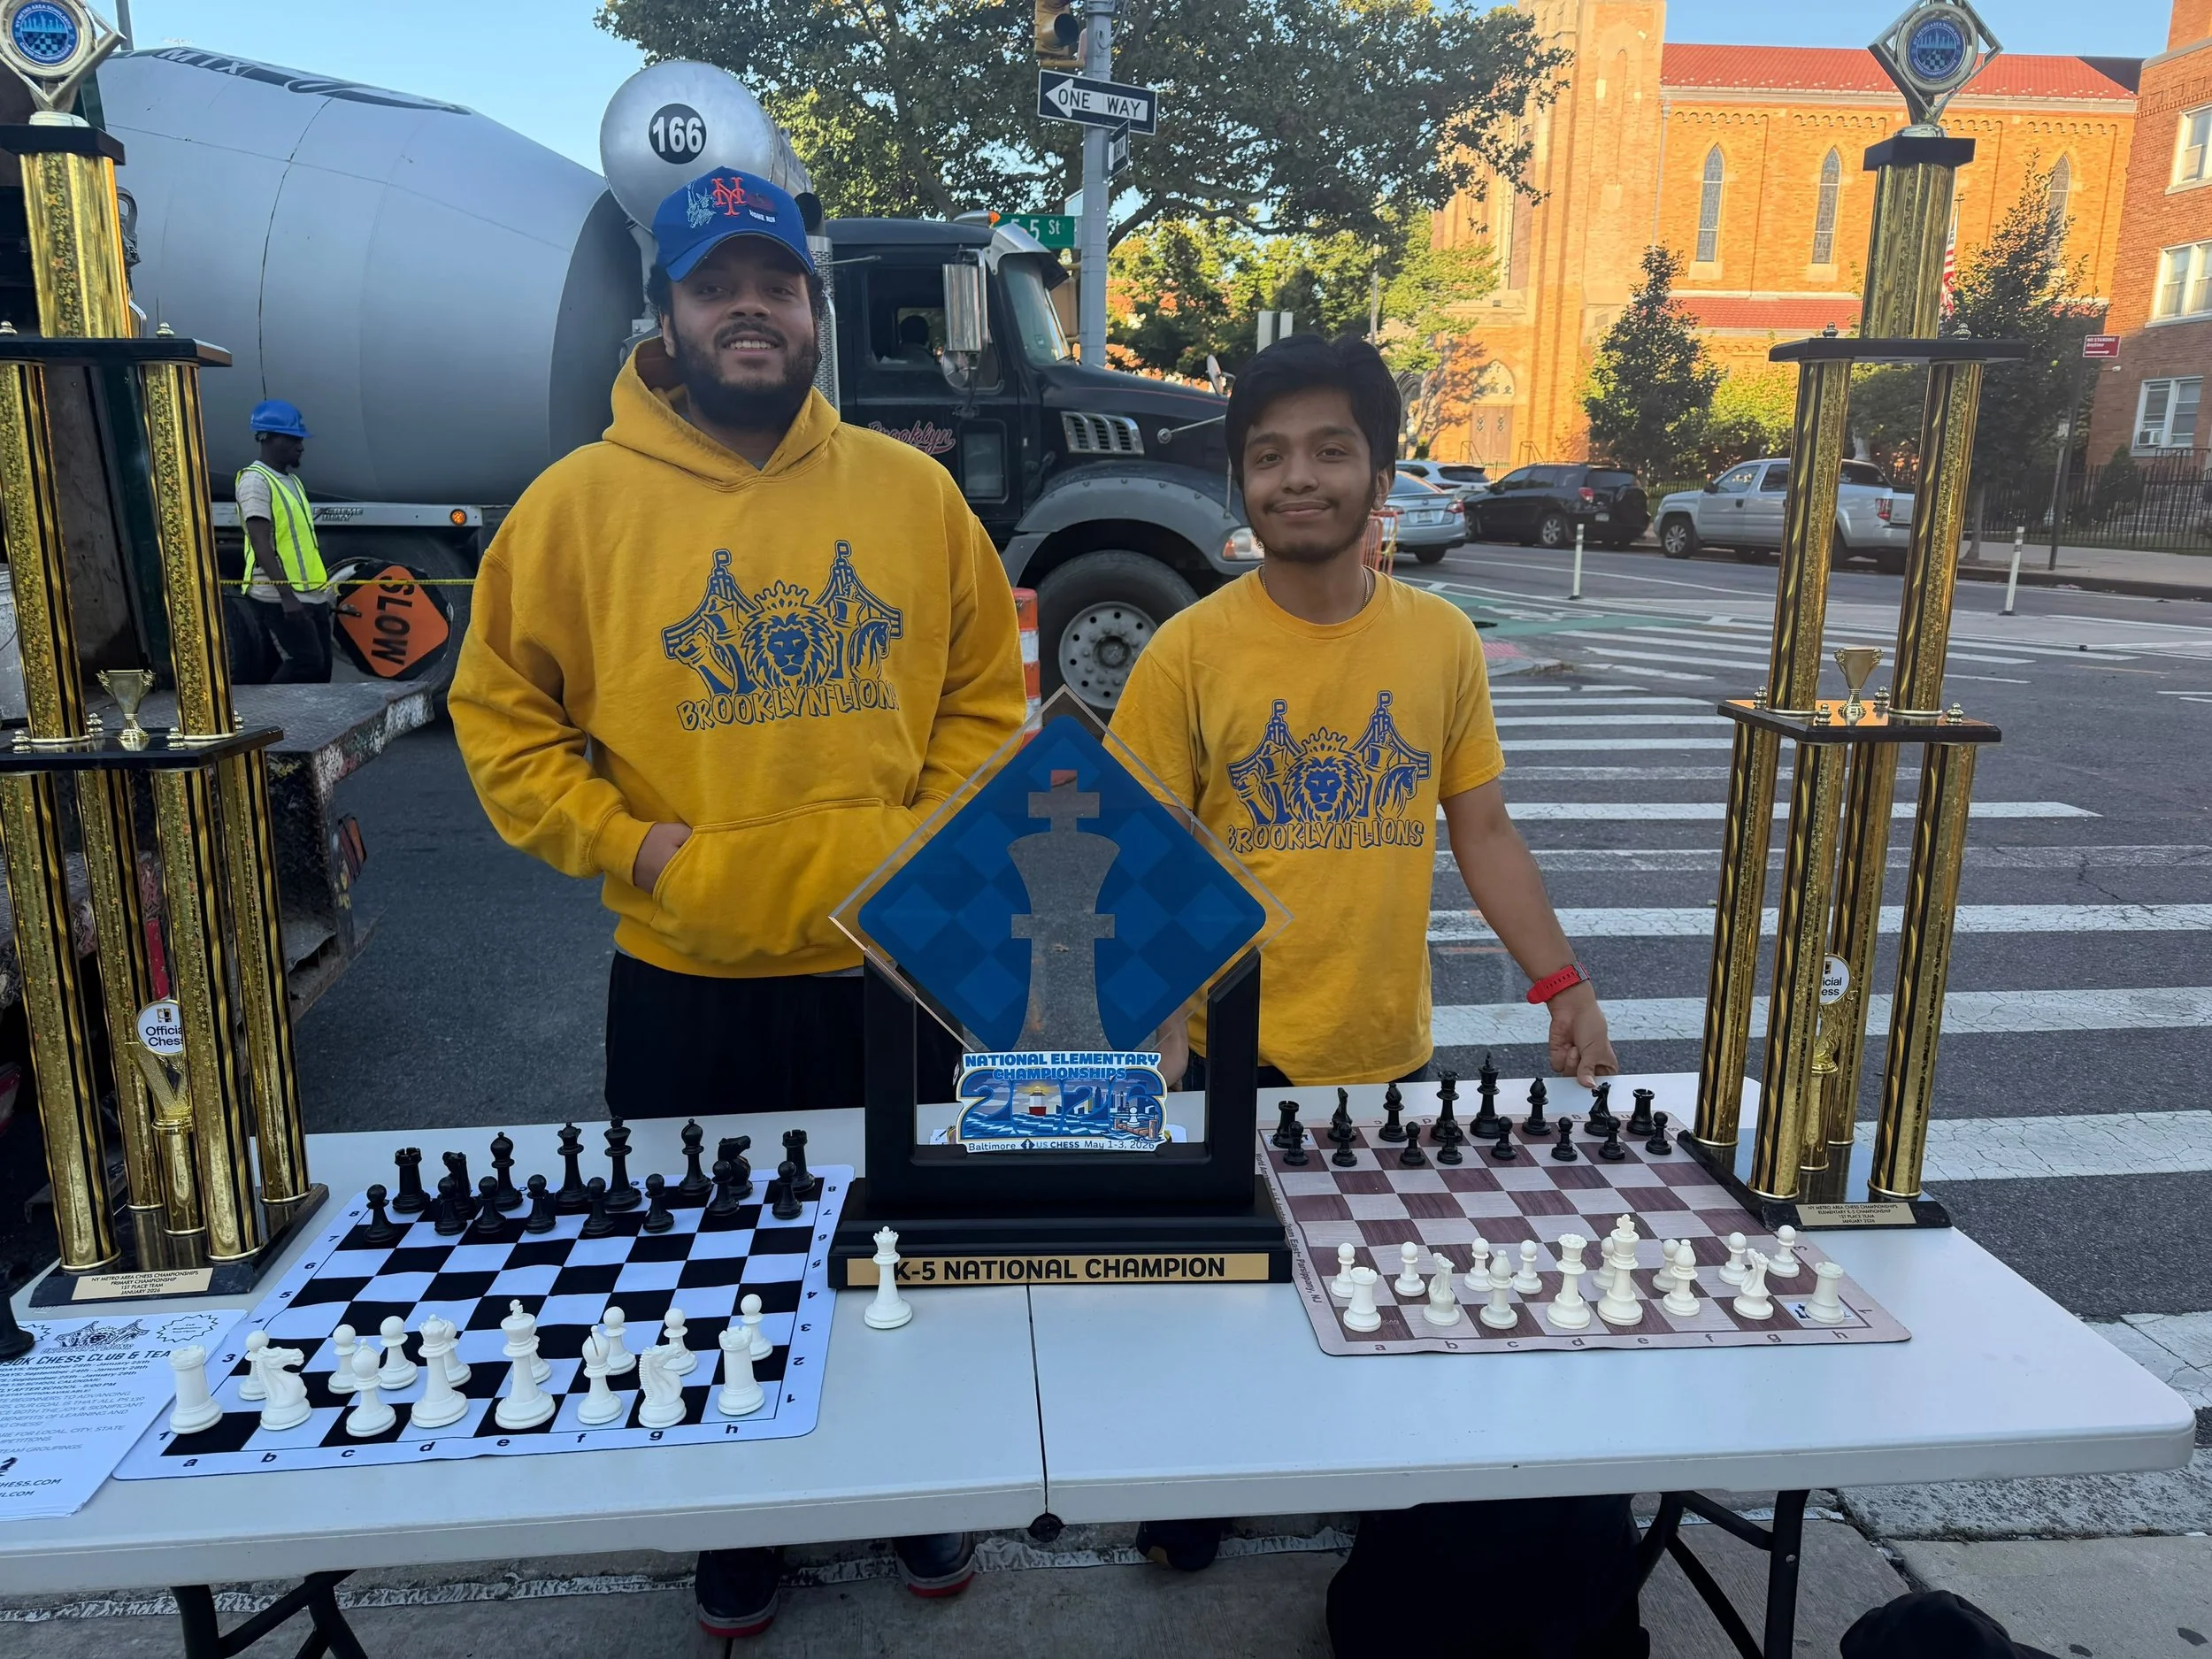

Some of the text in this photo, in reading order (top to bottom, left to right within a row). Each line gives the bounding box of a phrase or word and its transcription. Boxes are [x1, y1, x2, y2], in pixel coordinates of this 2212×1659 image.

[1058, 88, 1141, 118] ONE WAY
[652, 116, 703, 153] 166
[711, 177, 748, 217] NY
[1048, 219, 1061, 234] St
[372, 575, 415, 665] SLOW
[676, 679, 899, 731] BROOKLYN LION
[1228, 818, 1425, 854] BROOKLYN LIONS
[1822, 977, 1842, 986] icial
[145, 1025, 182, 1036] Officia
[965, 1052, 1160, 1067] NATIONAL ELEMENTARY
[992, 1067, 1127, 1080] CHAMPIONSHIPS
[968, 1142, 1017, 1151] Baltimore
[1050, 1141, 1080, 1149] CHESS
[1084, 1141, 1104, 1150] May
[1130, 1141, 1156, 1149] 2026
[893, 1257, 1225, 1281] K-5 NATIONAL CHAMPION
[1310, 1294, 1323, 1303] NJ
[1445, 1340, 1458, 1349] b
[1571, 1338, 1586, 1347] d
[36, 1355, 86, 1364] CHESS
[87, 1352, 126, 1362] CLUB
[143, 1350, 172, 1359] TEA
[183, 1458, 198, 1468] a
[261, 1453, 277, 1463] b
[419, 1441, 436, 1452] d
[496, 1438, 510, 1447] e
[577, 1432, 586, 1443] f
[649, 1431, 664, 1440] g
[726, 1424, 738, 1434] h
[0, 1479, 63, 1487] HESS.COM
